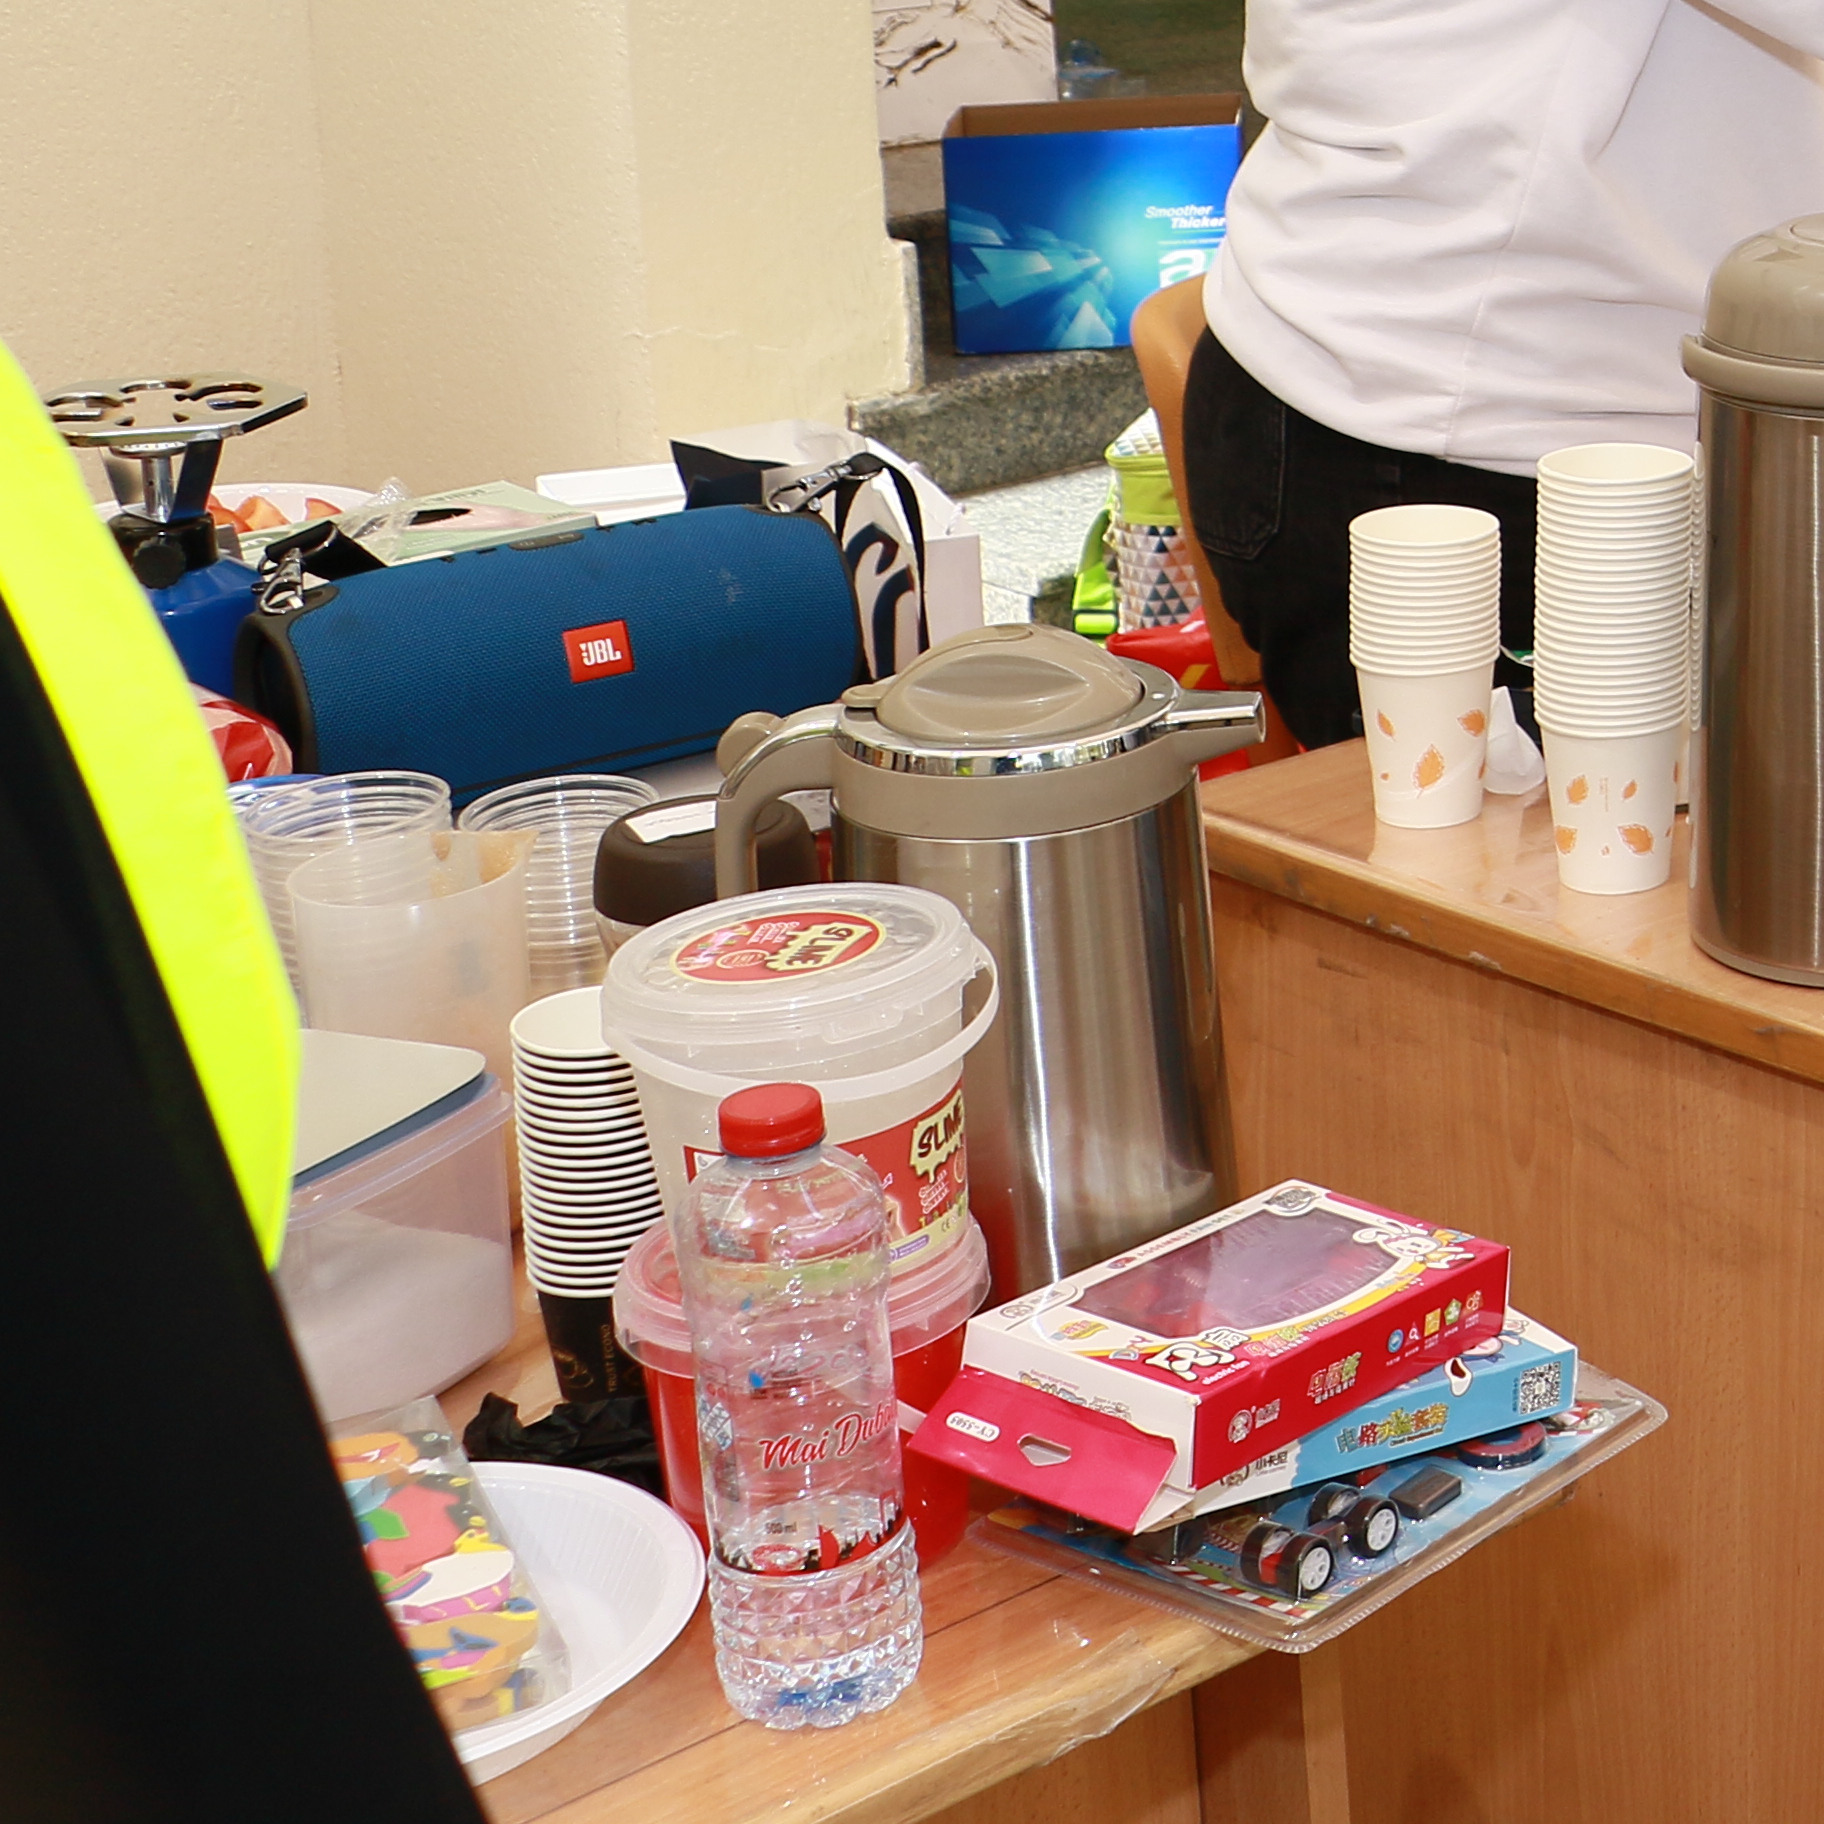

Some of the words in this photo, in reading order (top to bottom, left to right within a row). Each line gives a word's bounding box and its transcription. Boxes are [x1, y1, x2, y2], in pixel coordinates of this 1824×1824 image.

[1144, 203, 1214, 219] Smoother
[1170, 215, 1227, 230] Thicker
[578, 637, 623, 667] JBL
[916, 1094, 964, 1159] SLIME
[758, 1430, 831, 1470] Mai
[833, 1401, 897, 1457] Duba
